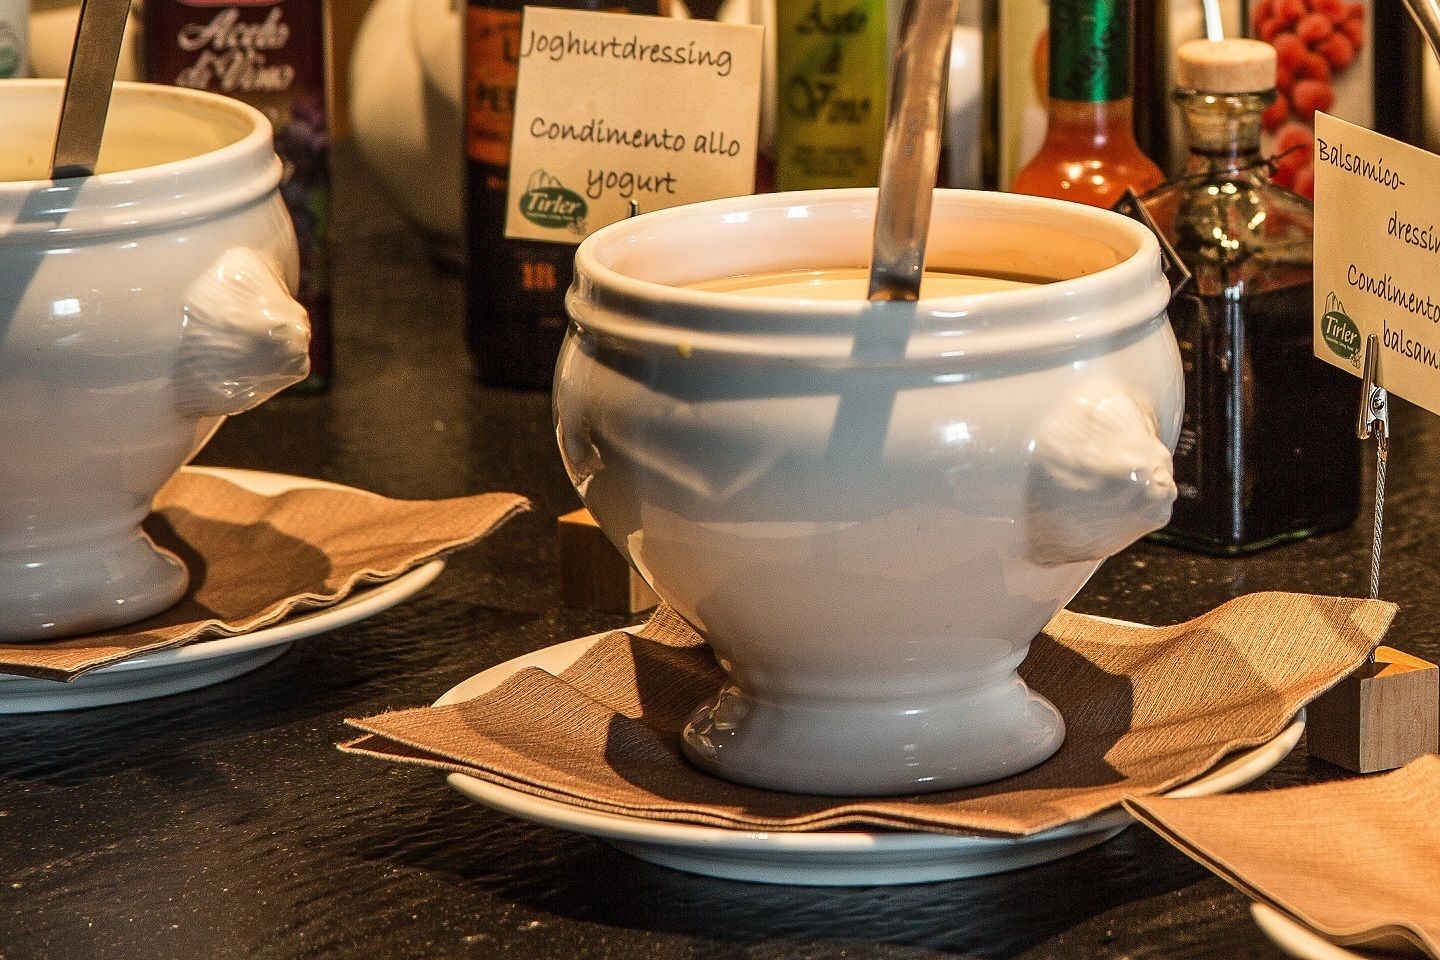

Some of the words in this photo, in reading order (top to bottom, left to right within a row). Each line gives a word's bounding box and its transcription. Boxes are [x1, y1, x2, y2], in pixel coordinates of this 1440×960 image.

[177, 7, 291, 52] Aceto
[521, 29, 734, 77] Joghurtdressing
[529, 116, 686, 153] Condimento
[693, 130, 741, 157] allo
[585, 167, 678, 199] yogurt
[1317, 137, 1406, 190] Balsamico-
[1347, 263, 1440, 323] Condimento
[1326, 315, 1358, 345] Tirler
